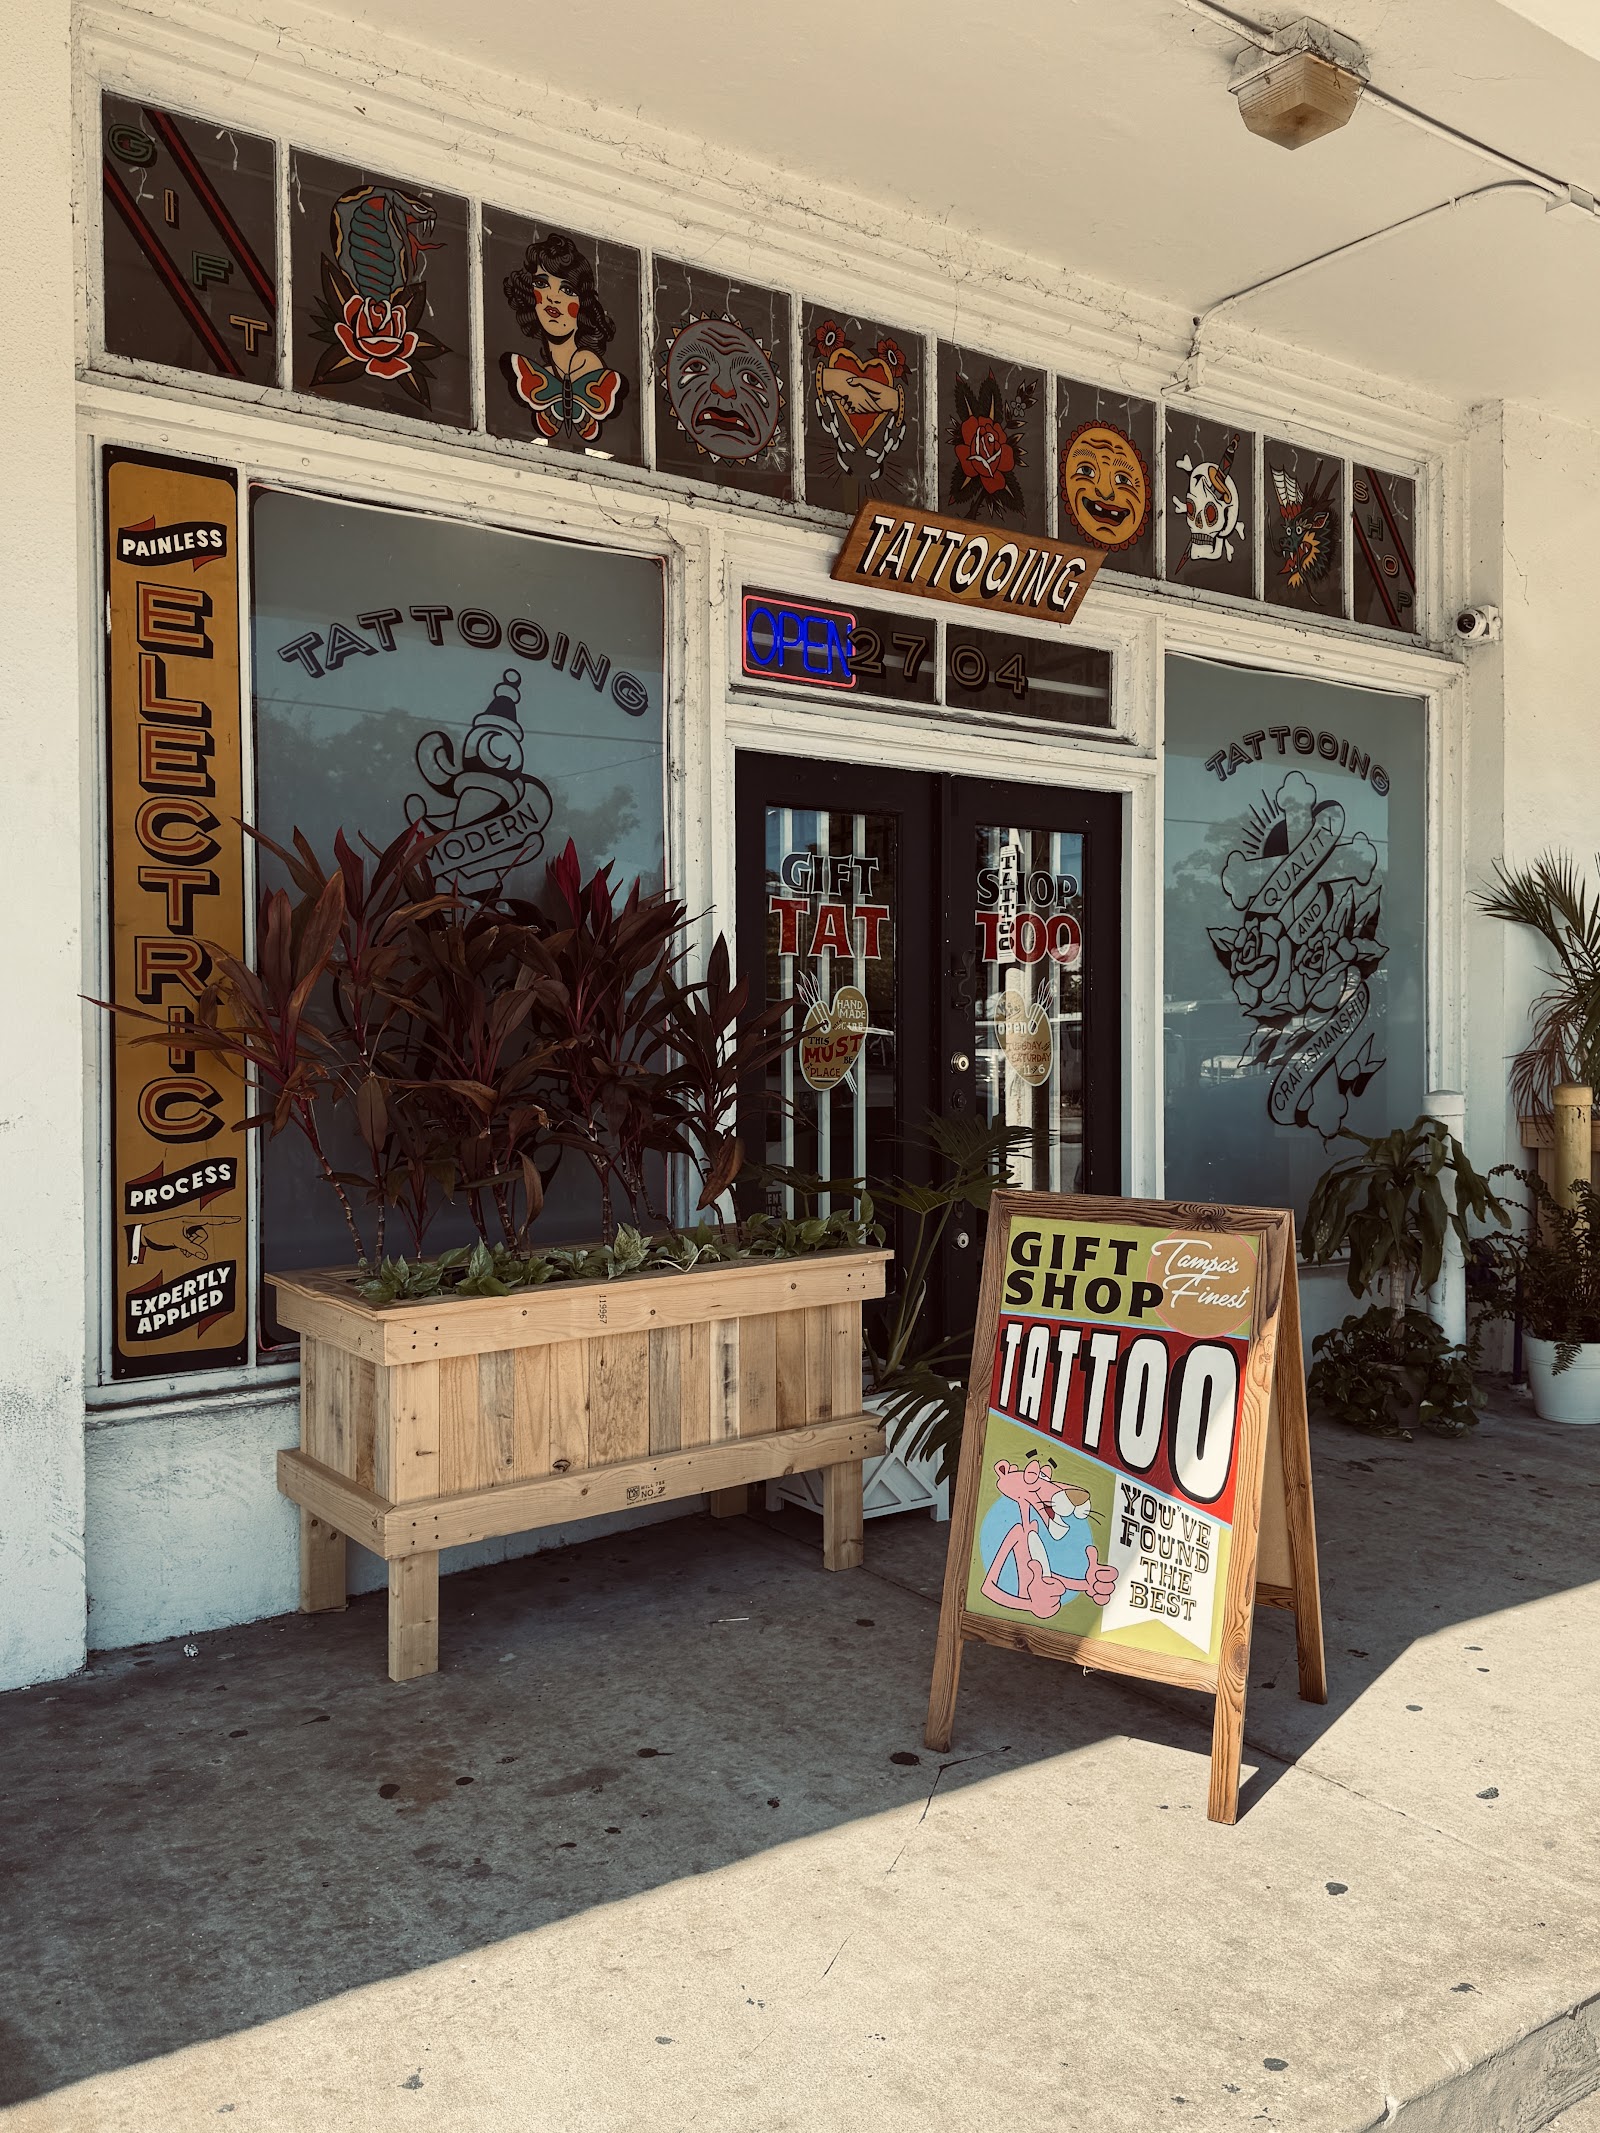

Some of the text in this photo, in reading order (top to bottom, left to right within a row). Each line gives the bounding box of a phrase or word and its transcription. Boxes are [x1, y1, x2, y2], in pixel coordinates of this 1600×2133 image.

[108, 123, 271, 356] GIFT
[122, 528, 223, 557] PAINLESS
[857, 514, 1087, 613] TATTOOING
[1353, 479, 1413, 613] SHOP
[277, 605, 649, 716] TATTOOING
[746, 607, 851, 677] OPEN
[846, 626, 1028, 698] 2704
[1205, 725, 1389, 796] TATTOOING
[135, 581, 226, 1144] ELECTRIC
[781, 852, 879, 897] GIFT
[1263, 816, 1335, 908] QUALITY
[769, 895, 1082, 964] TAT TOO
[1298, 904, 1322, 938] AND
[837, 1000, 863, 1010] HAND
[839, 1009, 866, 1020] MADE
[803, 1033, 866, 1066] MUST
[808, 1036, 830, 1046] THIS
[843, 1056, 854, 1065] BE
[1012, 1052, 1052, 1063] SATURDAY
[1274, 991, 1366, 1111] CRAFTSMANSHIP
[810, 1067, 840, 1078] PLACE
[1038, 1063, 1046, 1074] 6
[130, 1163, 231, 1208] PROCESS
[1010, 1231, 1138, 1276] GIFT
[1151, 1238, 1240, 1286] Tampa's
[130, 1266, 231, 1317] EXPERTLY
[137, 1290, 224, 1335] APPLIED
[1005, 1269, 1164, 1319] SHOP
[1162, 1273, 1250, 1309] Finest
[998, 1320, 1240, 1503] TATTOO
[1120, 1482, 1211, 1550] YOU'VE
[1120, 1514, 1210, 1574] FOUND
[1140, 1556, 1193, 1596] THE
[1129, 1580, 1197, 1621] BEST
